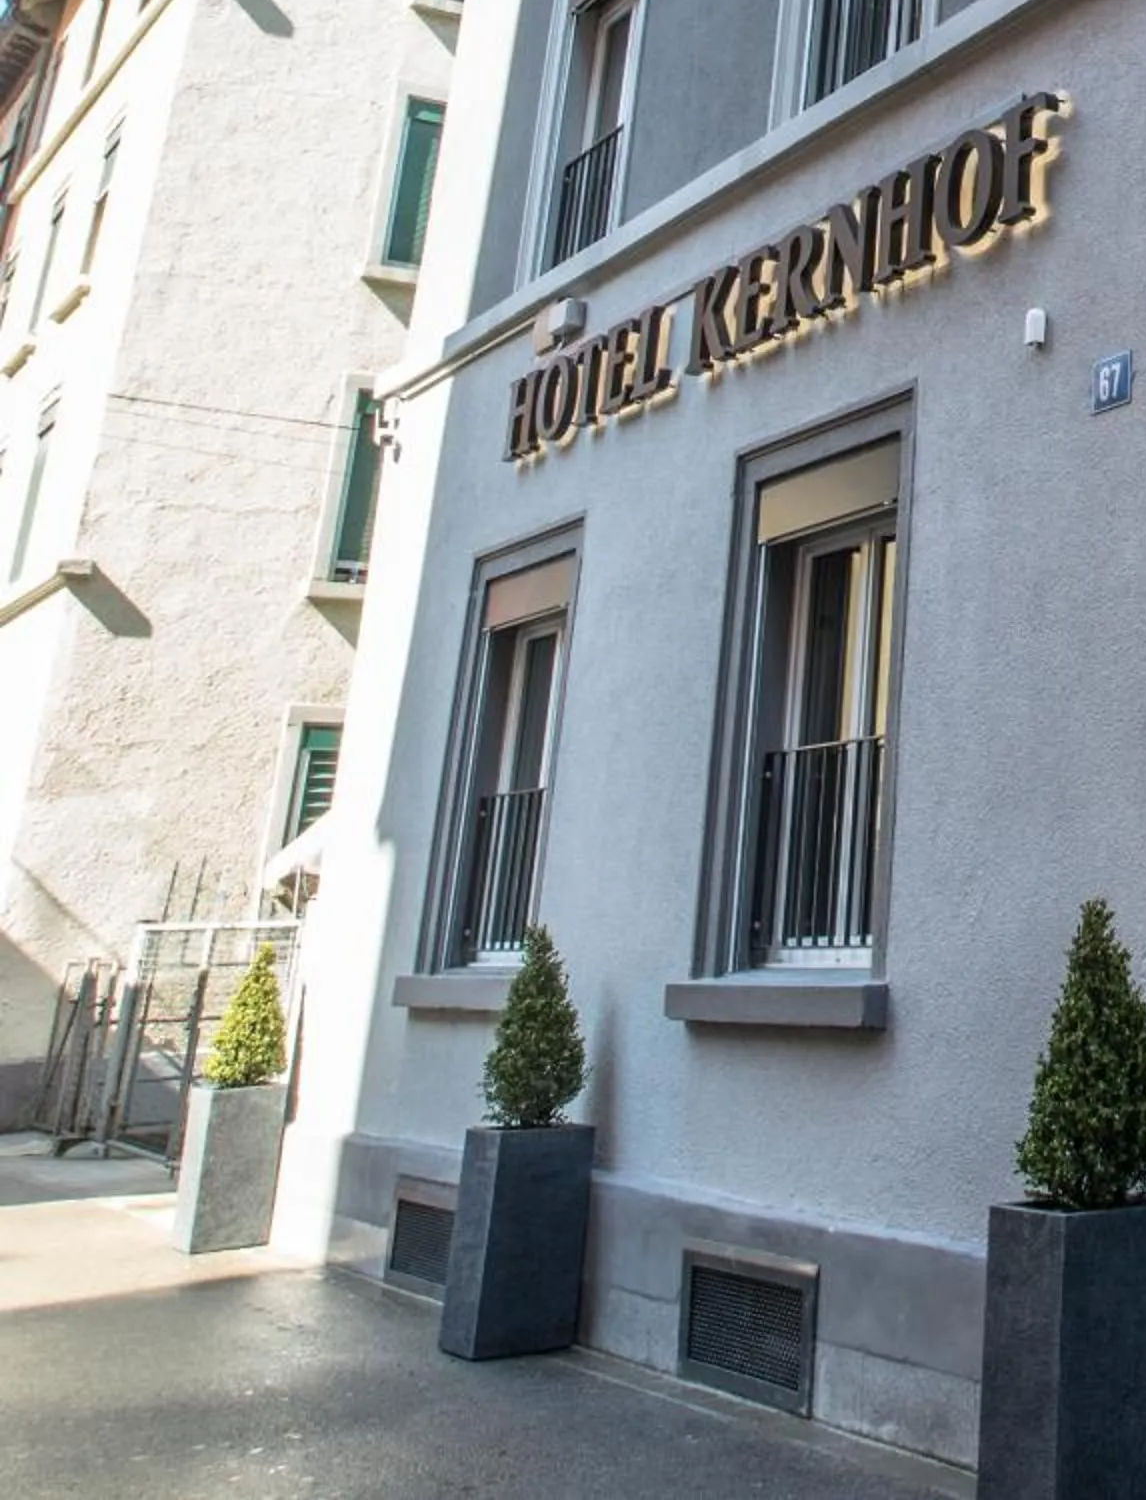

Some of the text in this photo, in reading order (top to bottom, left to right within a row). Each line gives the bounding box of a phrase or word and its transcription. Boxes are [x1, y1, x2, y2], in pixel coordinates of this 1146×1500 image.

[502, 91, 1059, 462] HOTEL KERNHOF
[1099, 362, 1121, 402] 67
